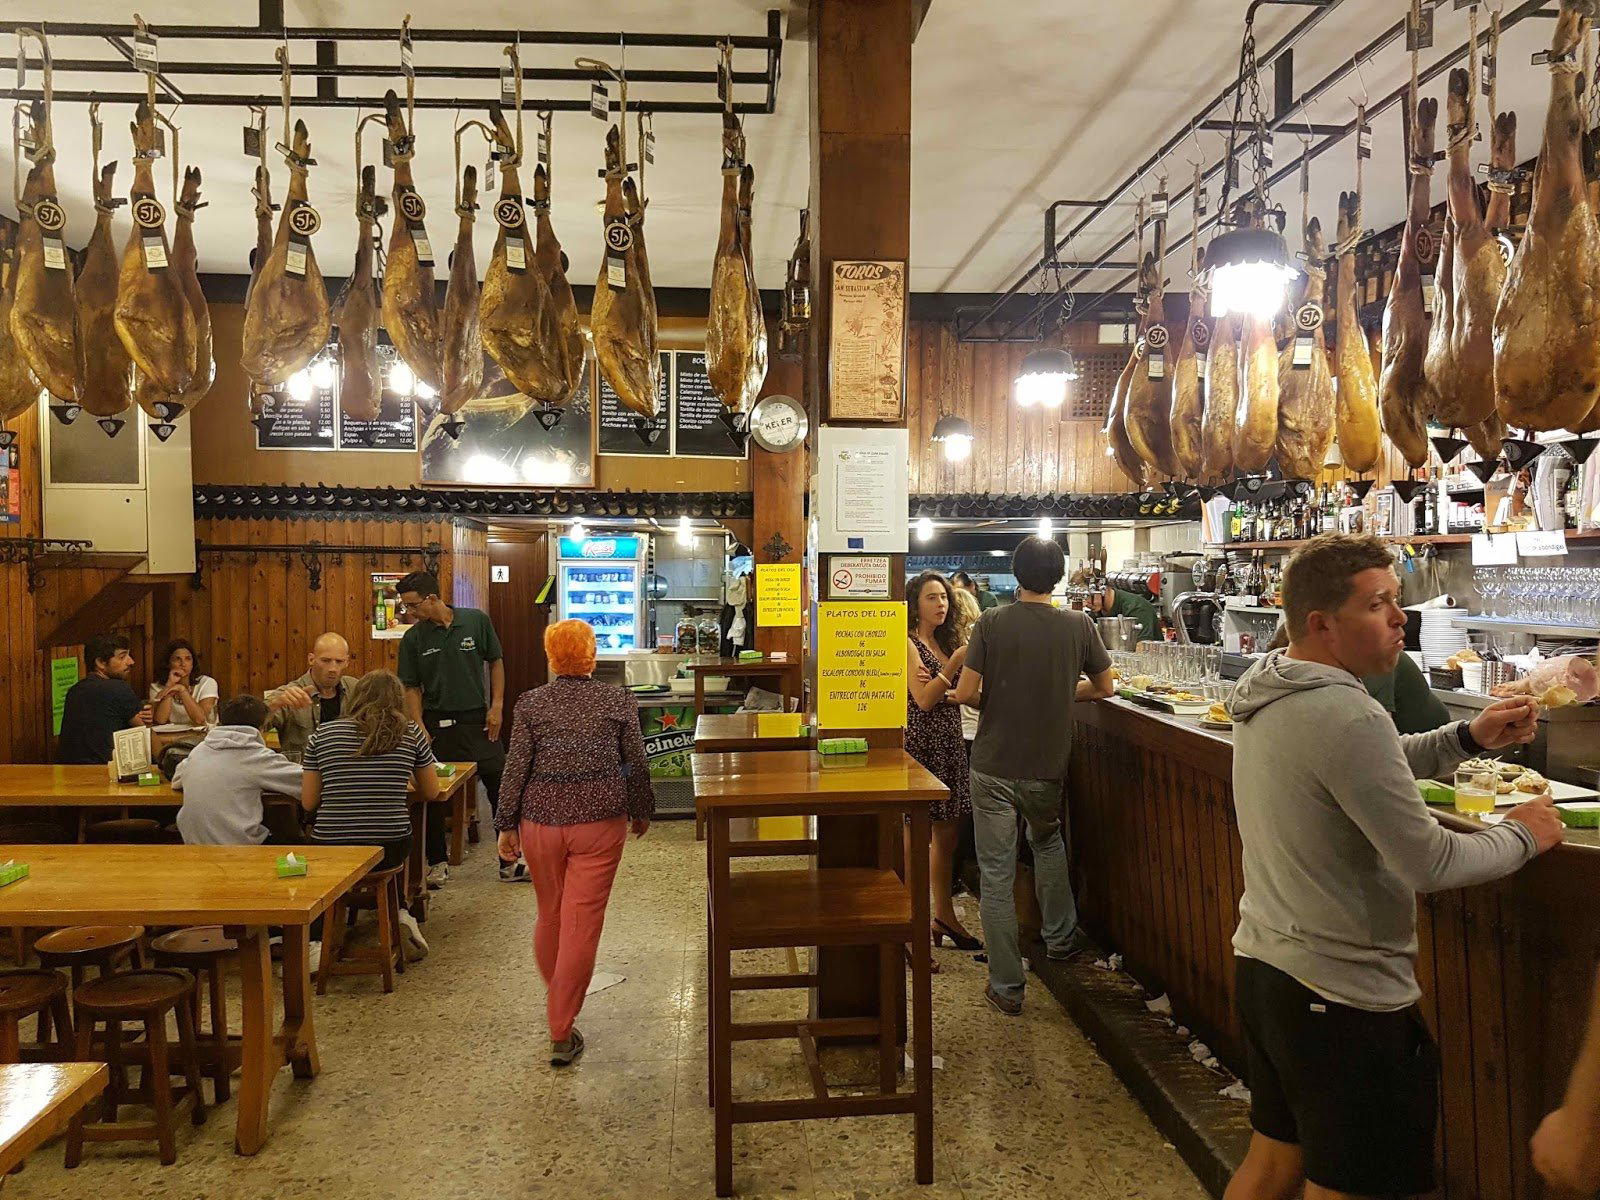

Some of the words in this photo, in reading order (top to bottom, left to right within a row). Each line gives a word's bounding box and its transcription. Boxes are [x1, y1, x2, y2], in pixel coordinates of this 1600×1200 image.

[840, 264, 884, 280] TOROS
[826, 610, 859, 618] PLATOS
[861, 610, 877, 618] DEL
[880, 610, 897, 618] DIA
[854, 630, 865, 638] CON
[865, 649, 872, 657] EN
[829, 691, 858, 700] ENTRECOT
[858, 691, 871, 700] CON
[871, 690, 895, 700] PATATAS
